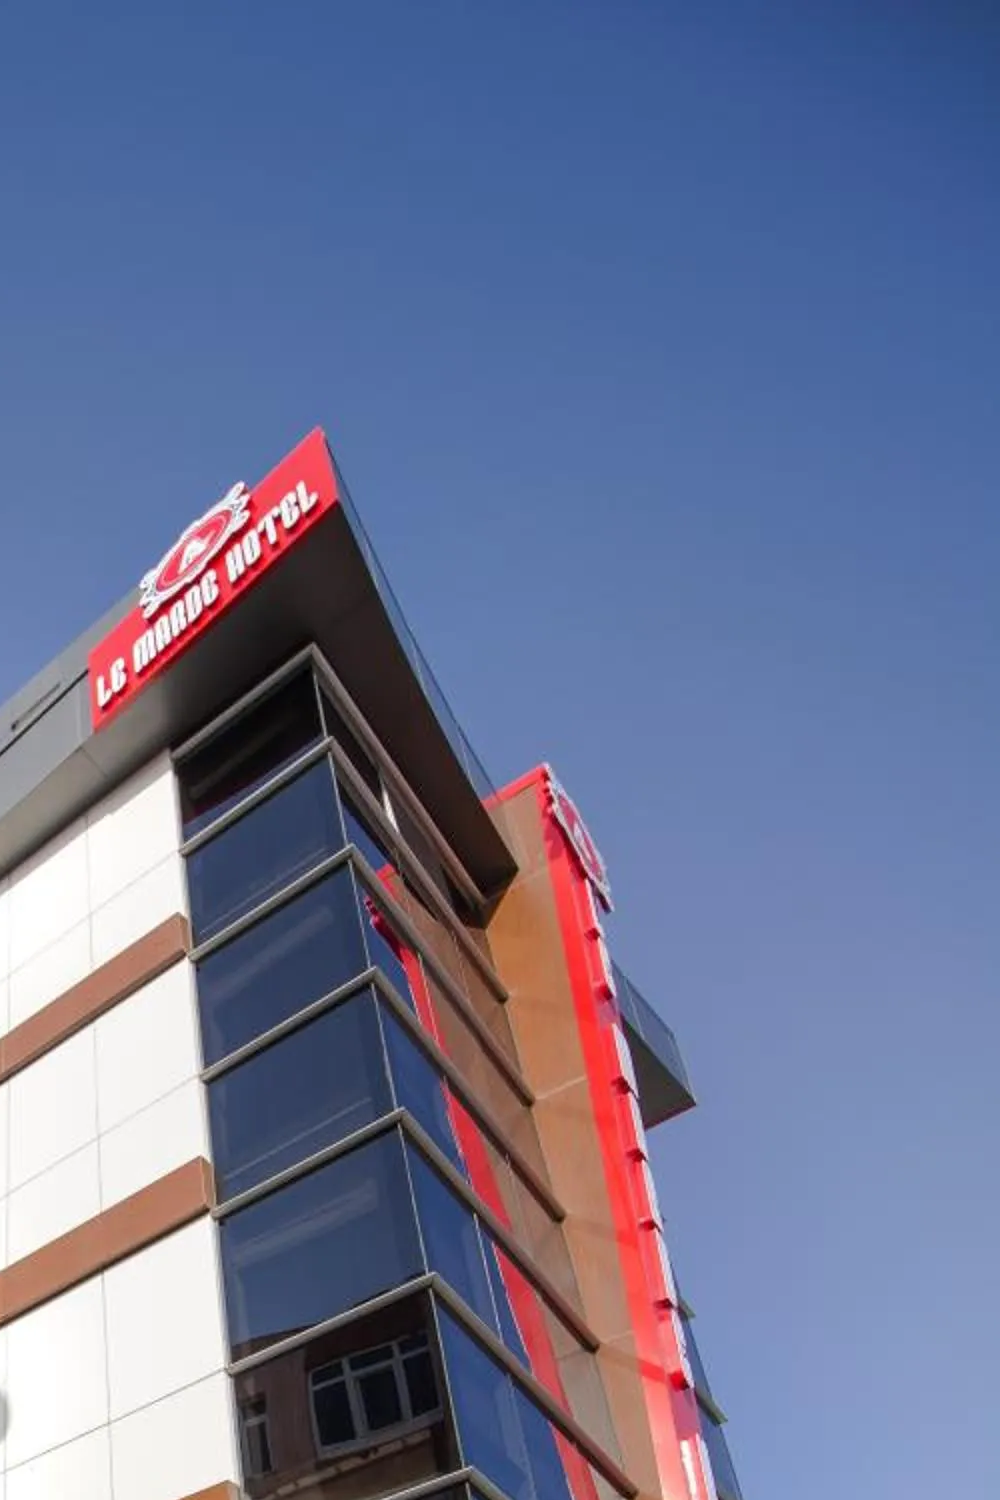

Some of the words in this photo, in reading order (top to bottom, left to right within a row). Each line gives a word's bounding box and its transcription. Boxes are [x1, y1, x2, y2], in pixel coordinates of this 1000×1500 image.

[96, 656, 127, 707] LE
[131, 570, 220, 673] MAROC
[224, 480, 319, 584] HOTEL
